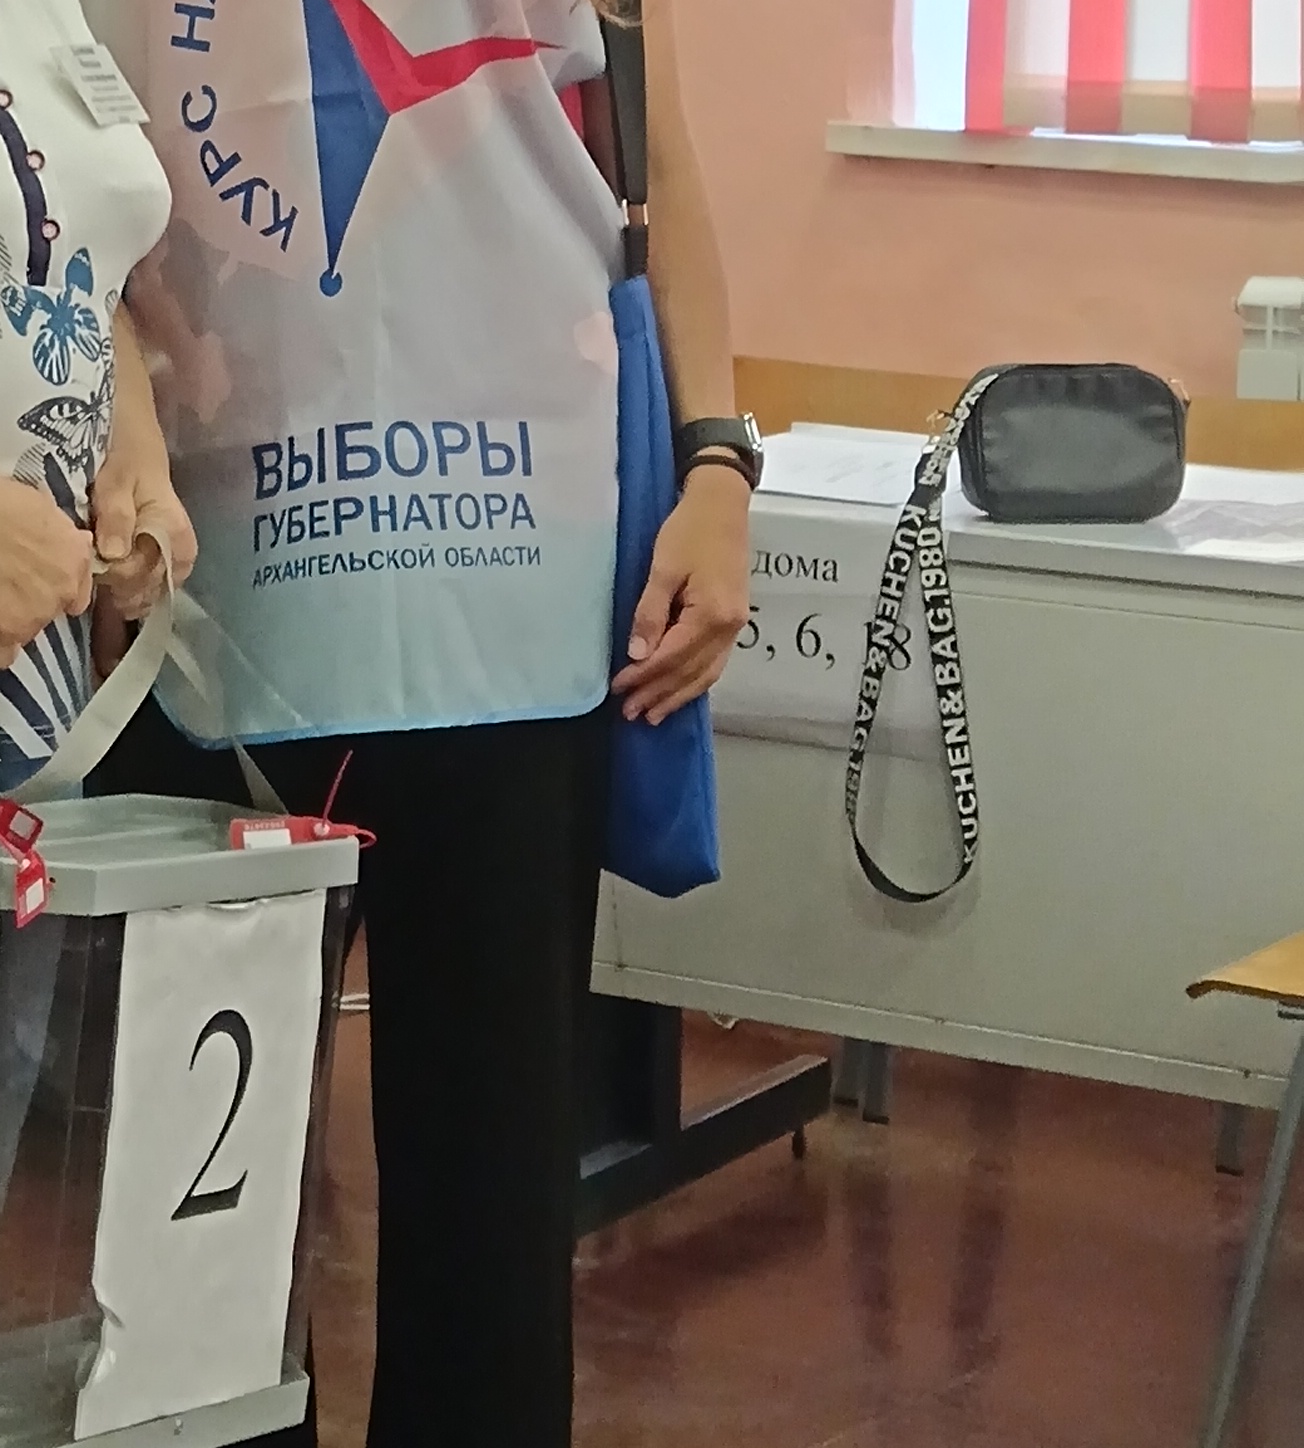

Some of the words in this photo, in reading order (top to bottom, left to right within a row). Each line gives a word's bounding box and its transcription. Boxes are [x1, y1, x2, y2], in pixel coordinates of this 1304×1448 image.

[180, 85, 299, 252] КУРС
[251, 419, 534, 501] ВЫБОРЫ
[252, 491, 537, 553] ГУБЕРНАТОРА
[252, 542, 436, 590] АРХАНГЕЛЬСКОЙ
[444, 545, 541, 569] ОБЛАСТИ
[751, 550, 839, 584] дома
[795, 612, 836, 671] 6,
[169, 1008, 255, 1222] 2
